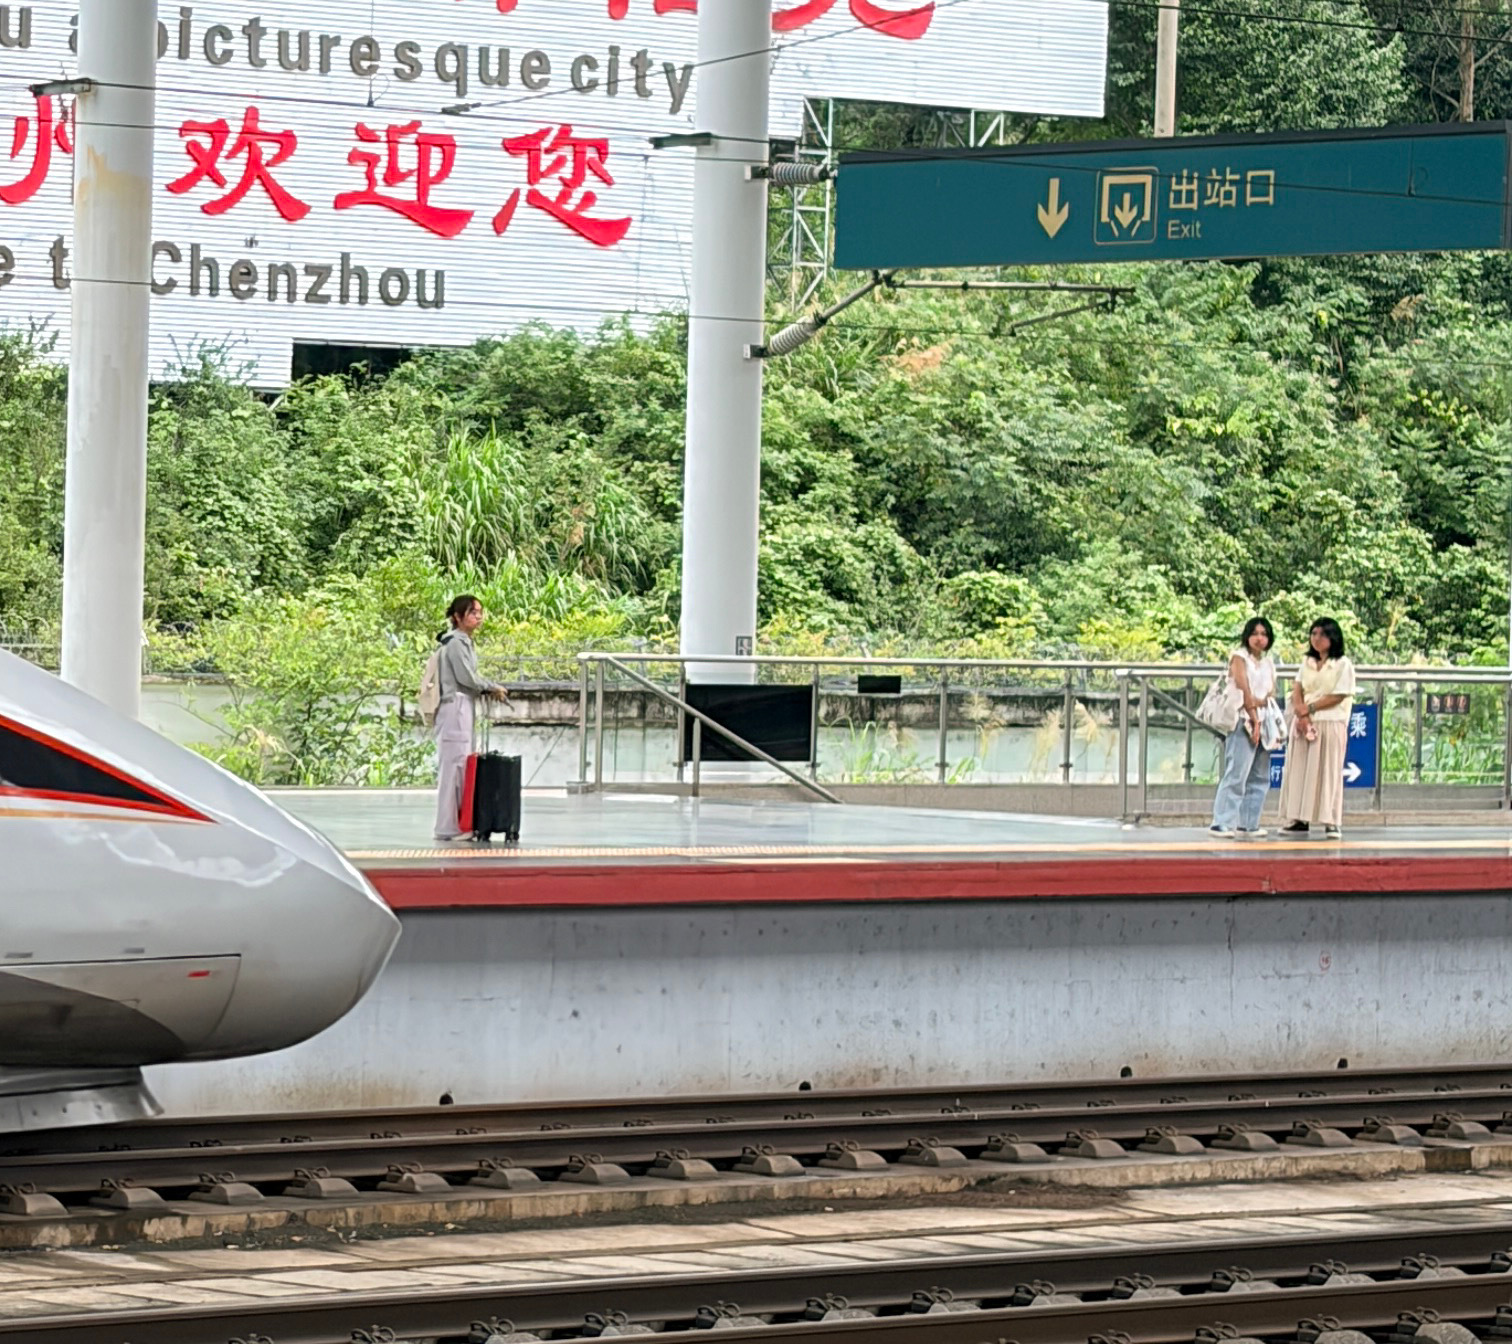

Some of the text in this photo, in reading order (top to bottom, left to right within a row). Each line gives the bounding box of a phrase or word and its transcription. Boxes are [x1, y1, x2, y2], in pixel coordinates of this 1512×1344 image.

[157, 6, 552, 96] icturesque
[570, 44, 694, 115] city
[1169, 166, 1275, 210] 出站口
[1168, 219, 1202, 239] Exit
[151, 239, 445, 309] Chenzhou
